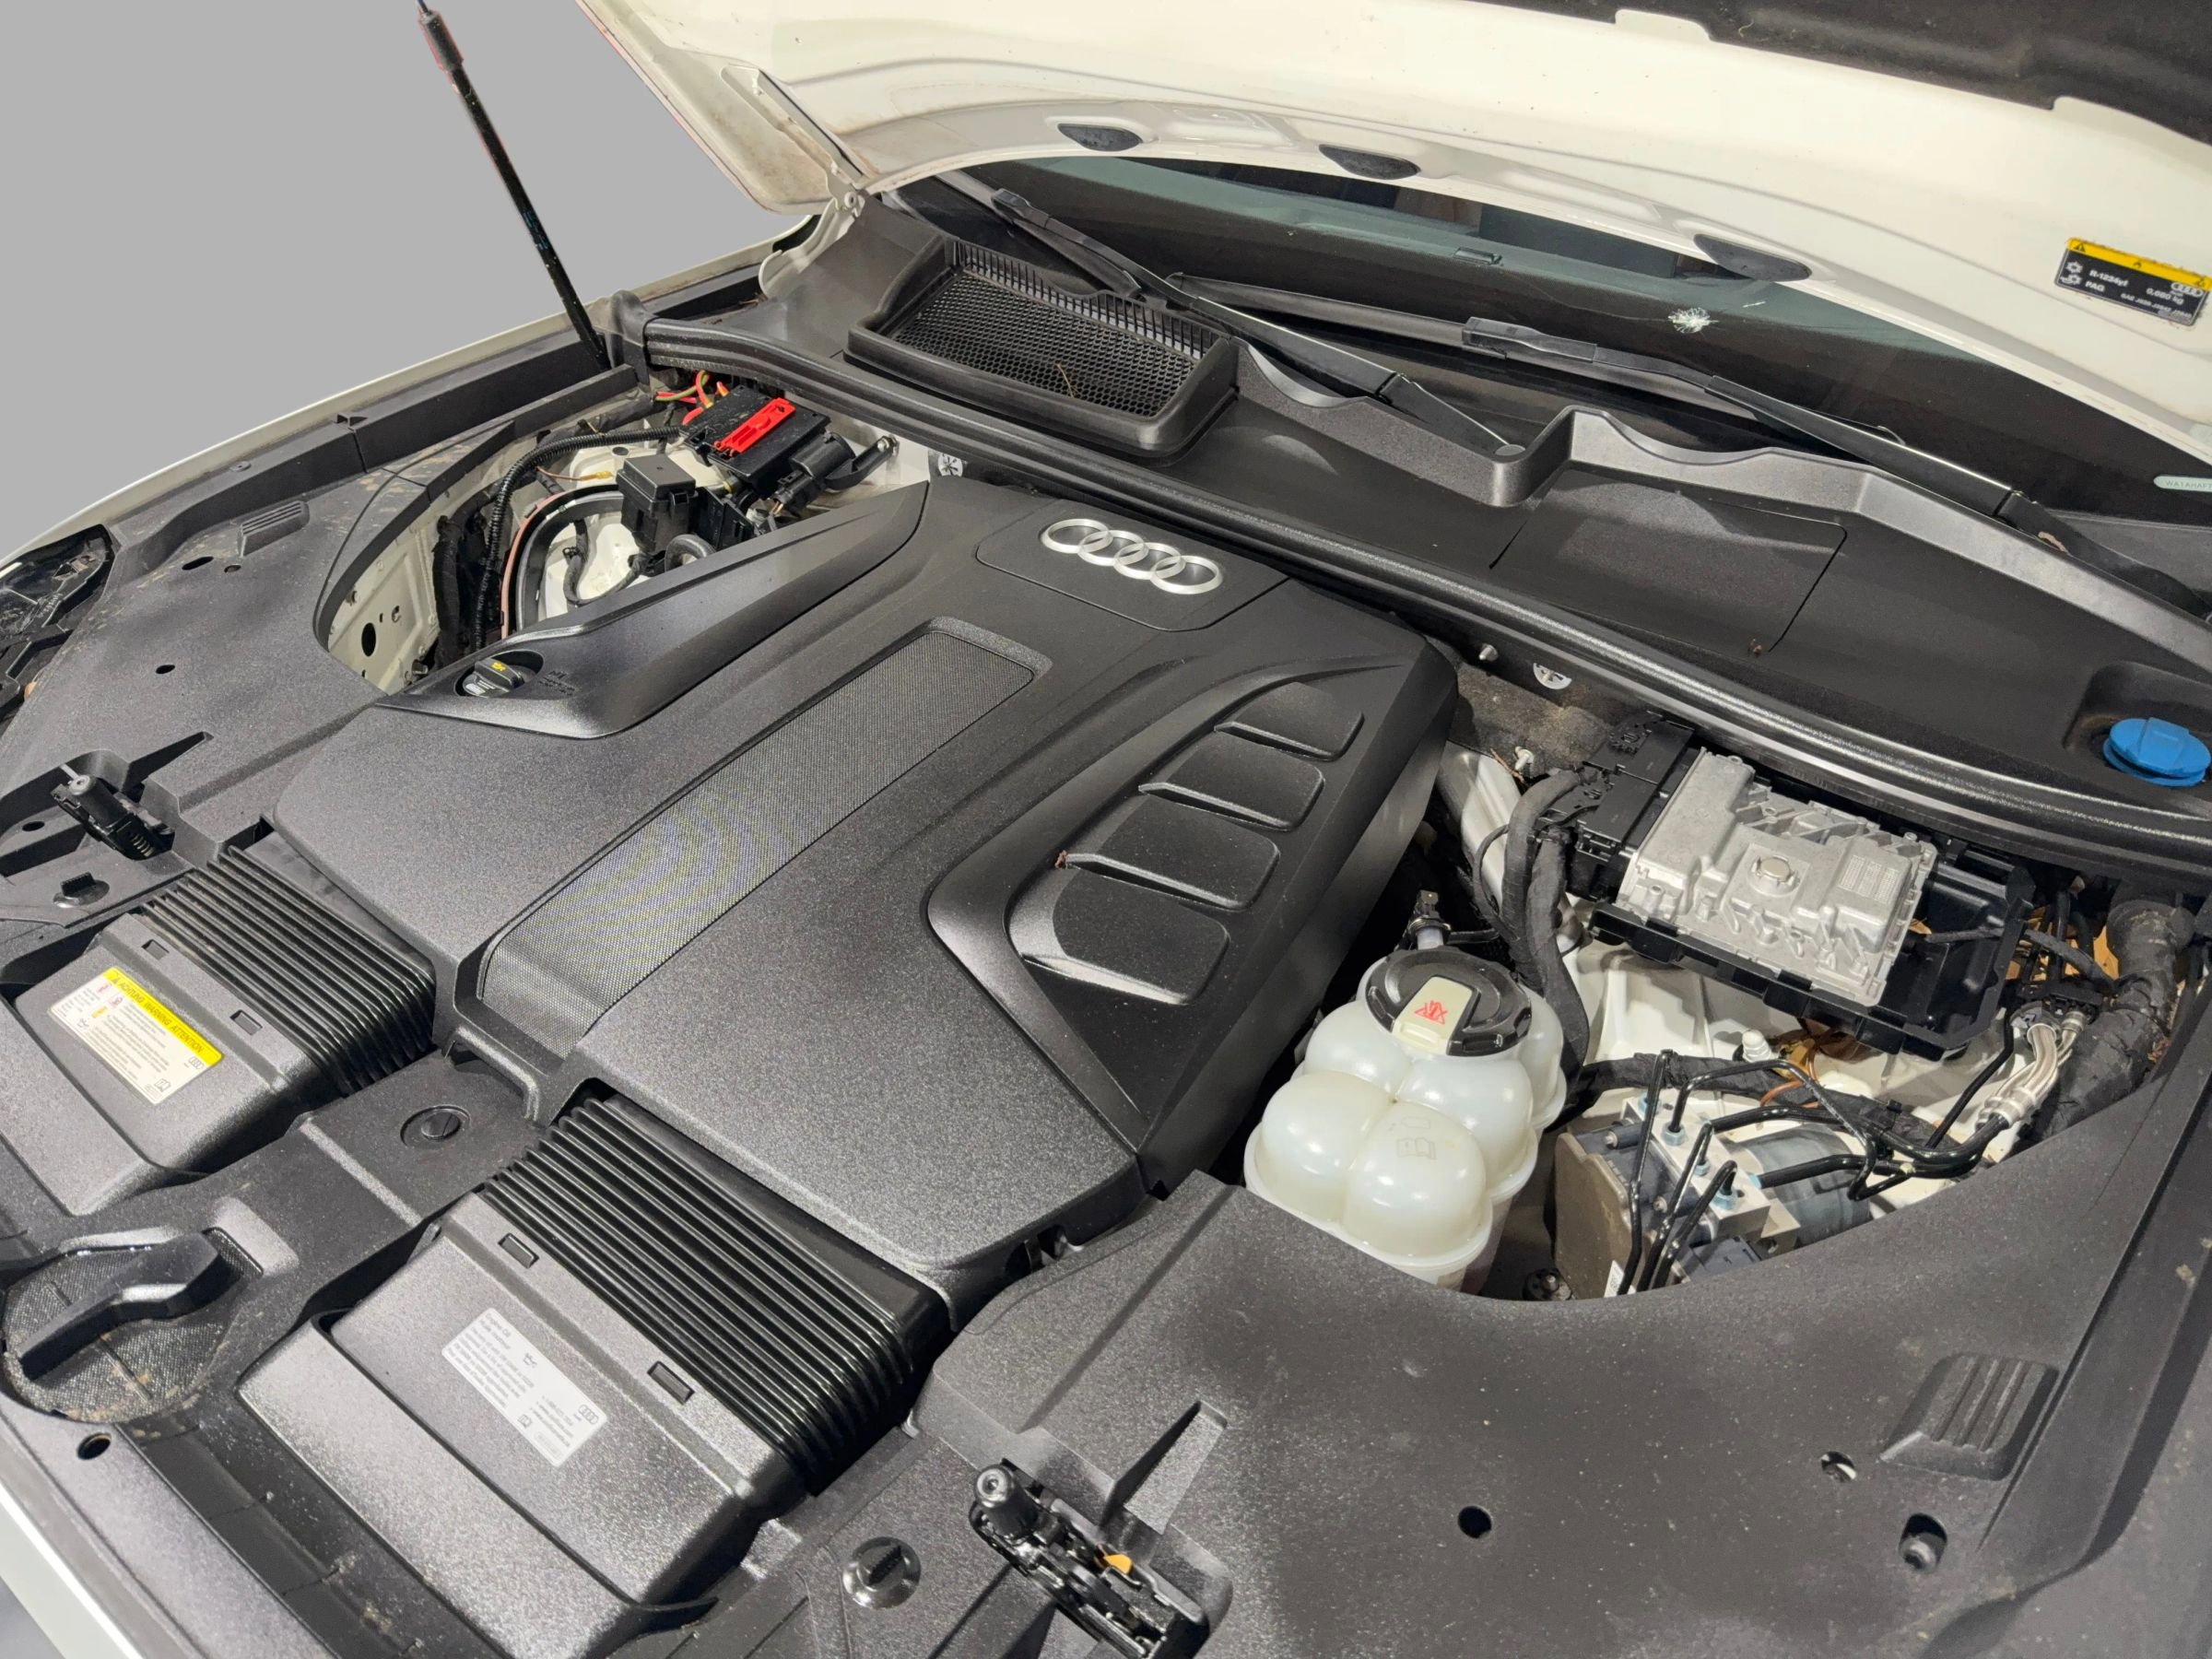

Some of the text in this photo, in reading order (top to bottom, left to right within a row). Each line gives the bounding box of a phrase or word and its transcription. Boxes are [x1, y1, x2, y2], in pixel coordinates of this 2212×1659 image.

[2086, 281, 2105, 292] PAG
[2089, 269, 2128, 287] R-1234yf
[119, 981, 145, 1004] ACHTUNG
[143, 1001, 171, 1026] WARNING
[170, 1022, 205, 1053] ATTENTION
